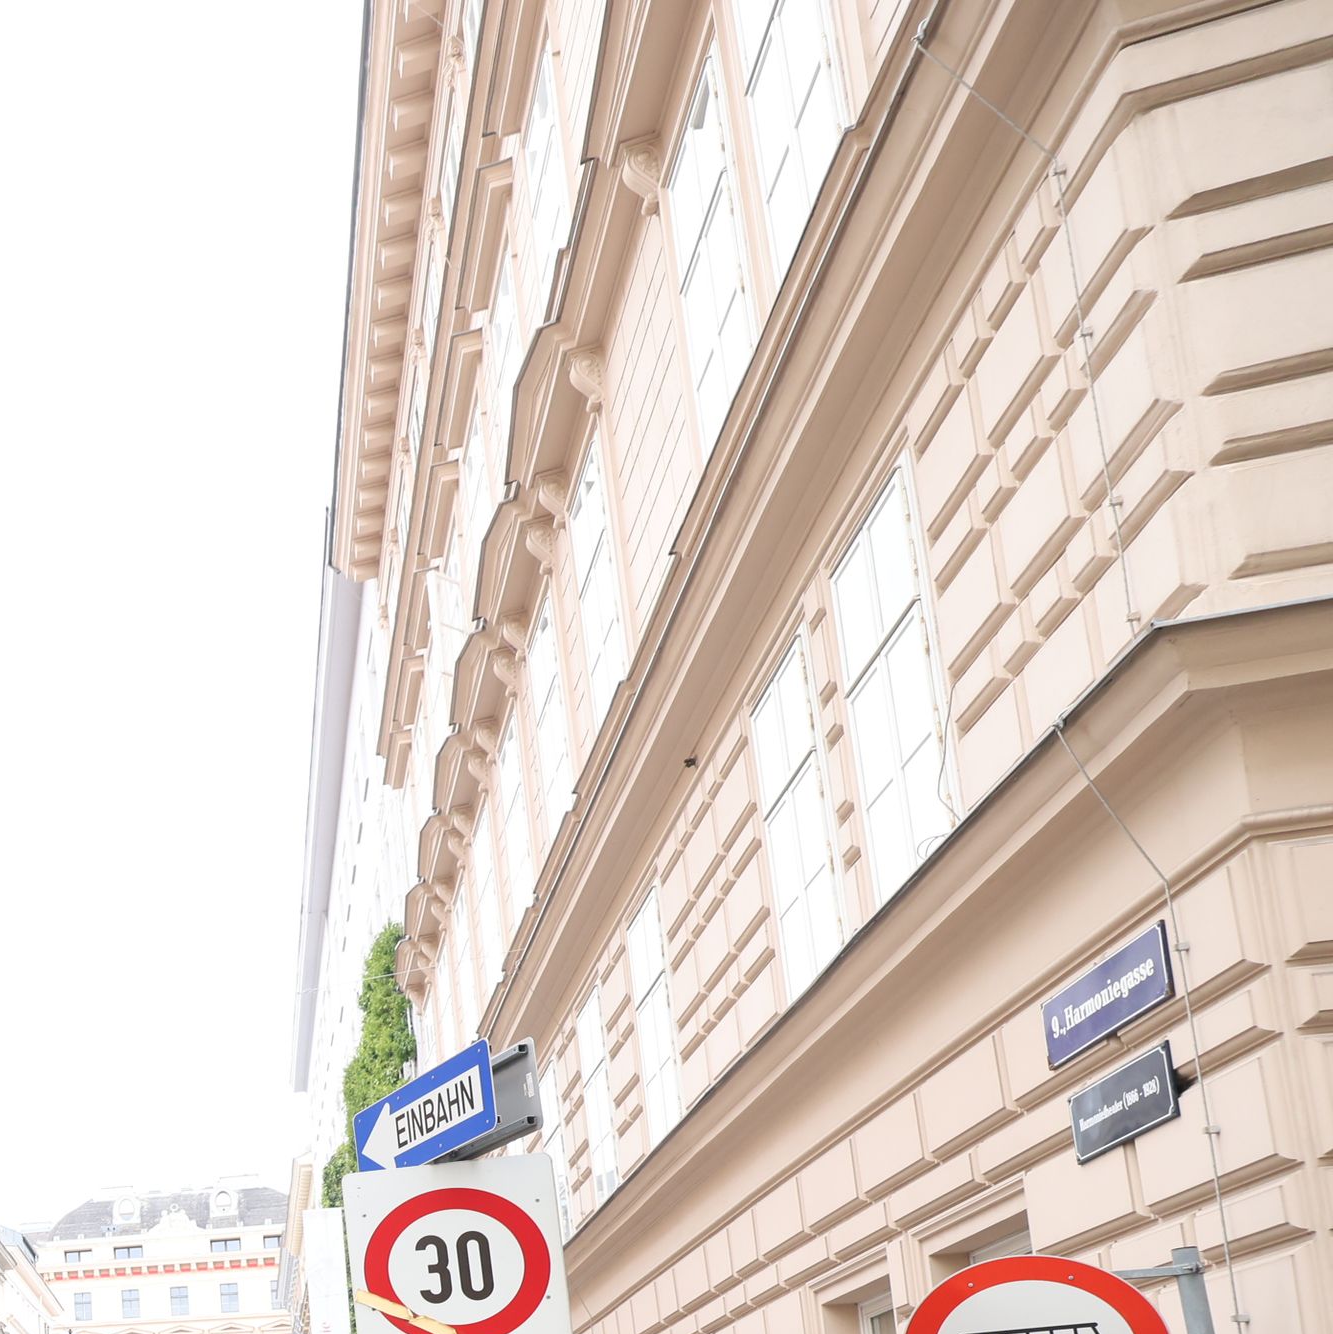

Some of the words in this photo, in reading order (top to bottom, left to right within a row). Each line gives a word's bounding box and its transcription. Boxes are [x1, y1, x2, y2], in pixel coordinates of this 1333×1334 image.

[1064, 958, 1155, 1030] Harmoniegasse
[395, 1075, 476, 1149] EINBAHN
[1143, 1075, 1161, 1103] 1928)
[414, 1231, 495, 1304] 30
